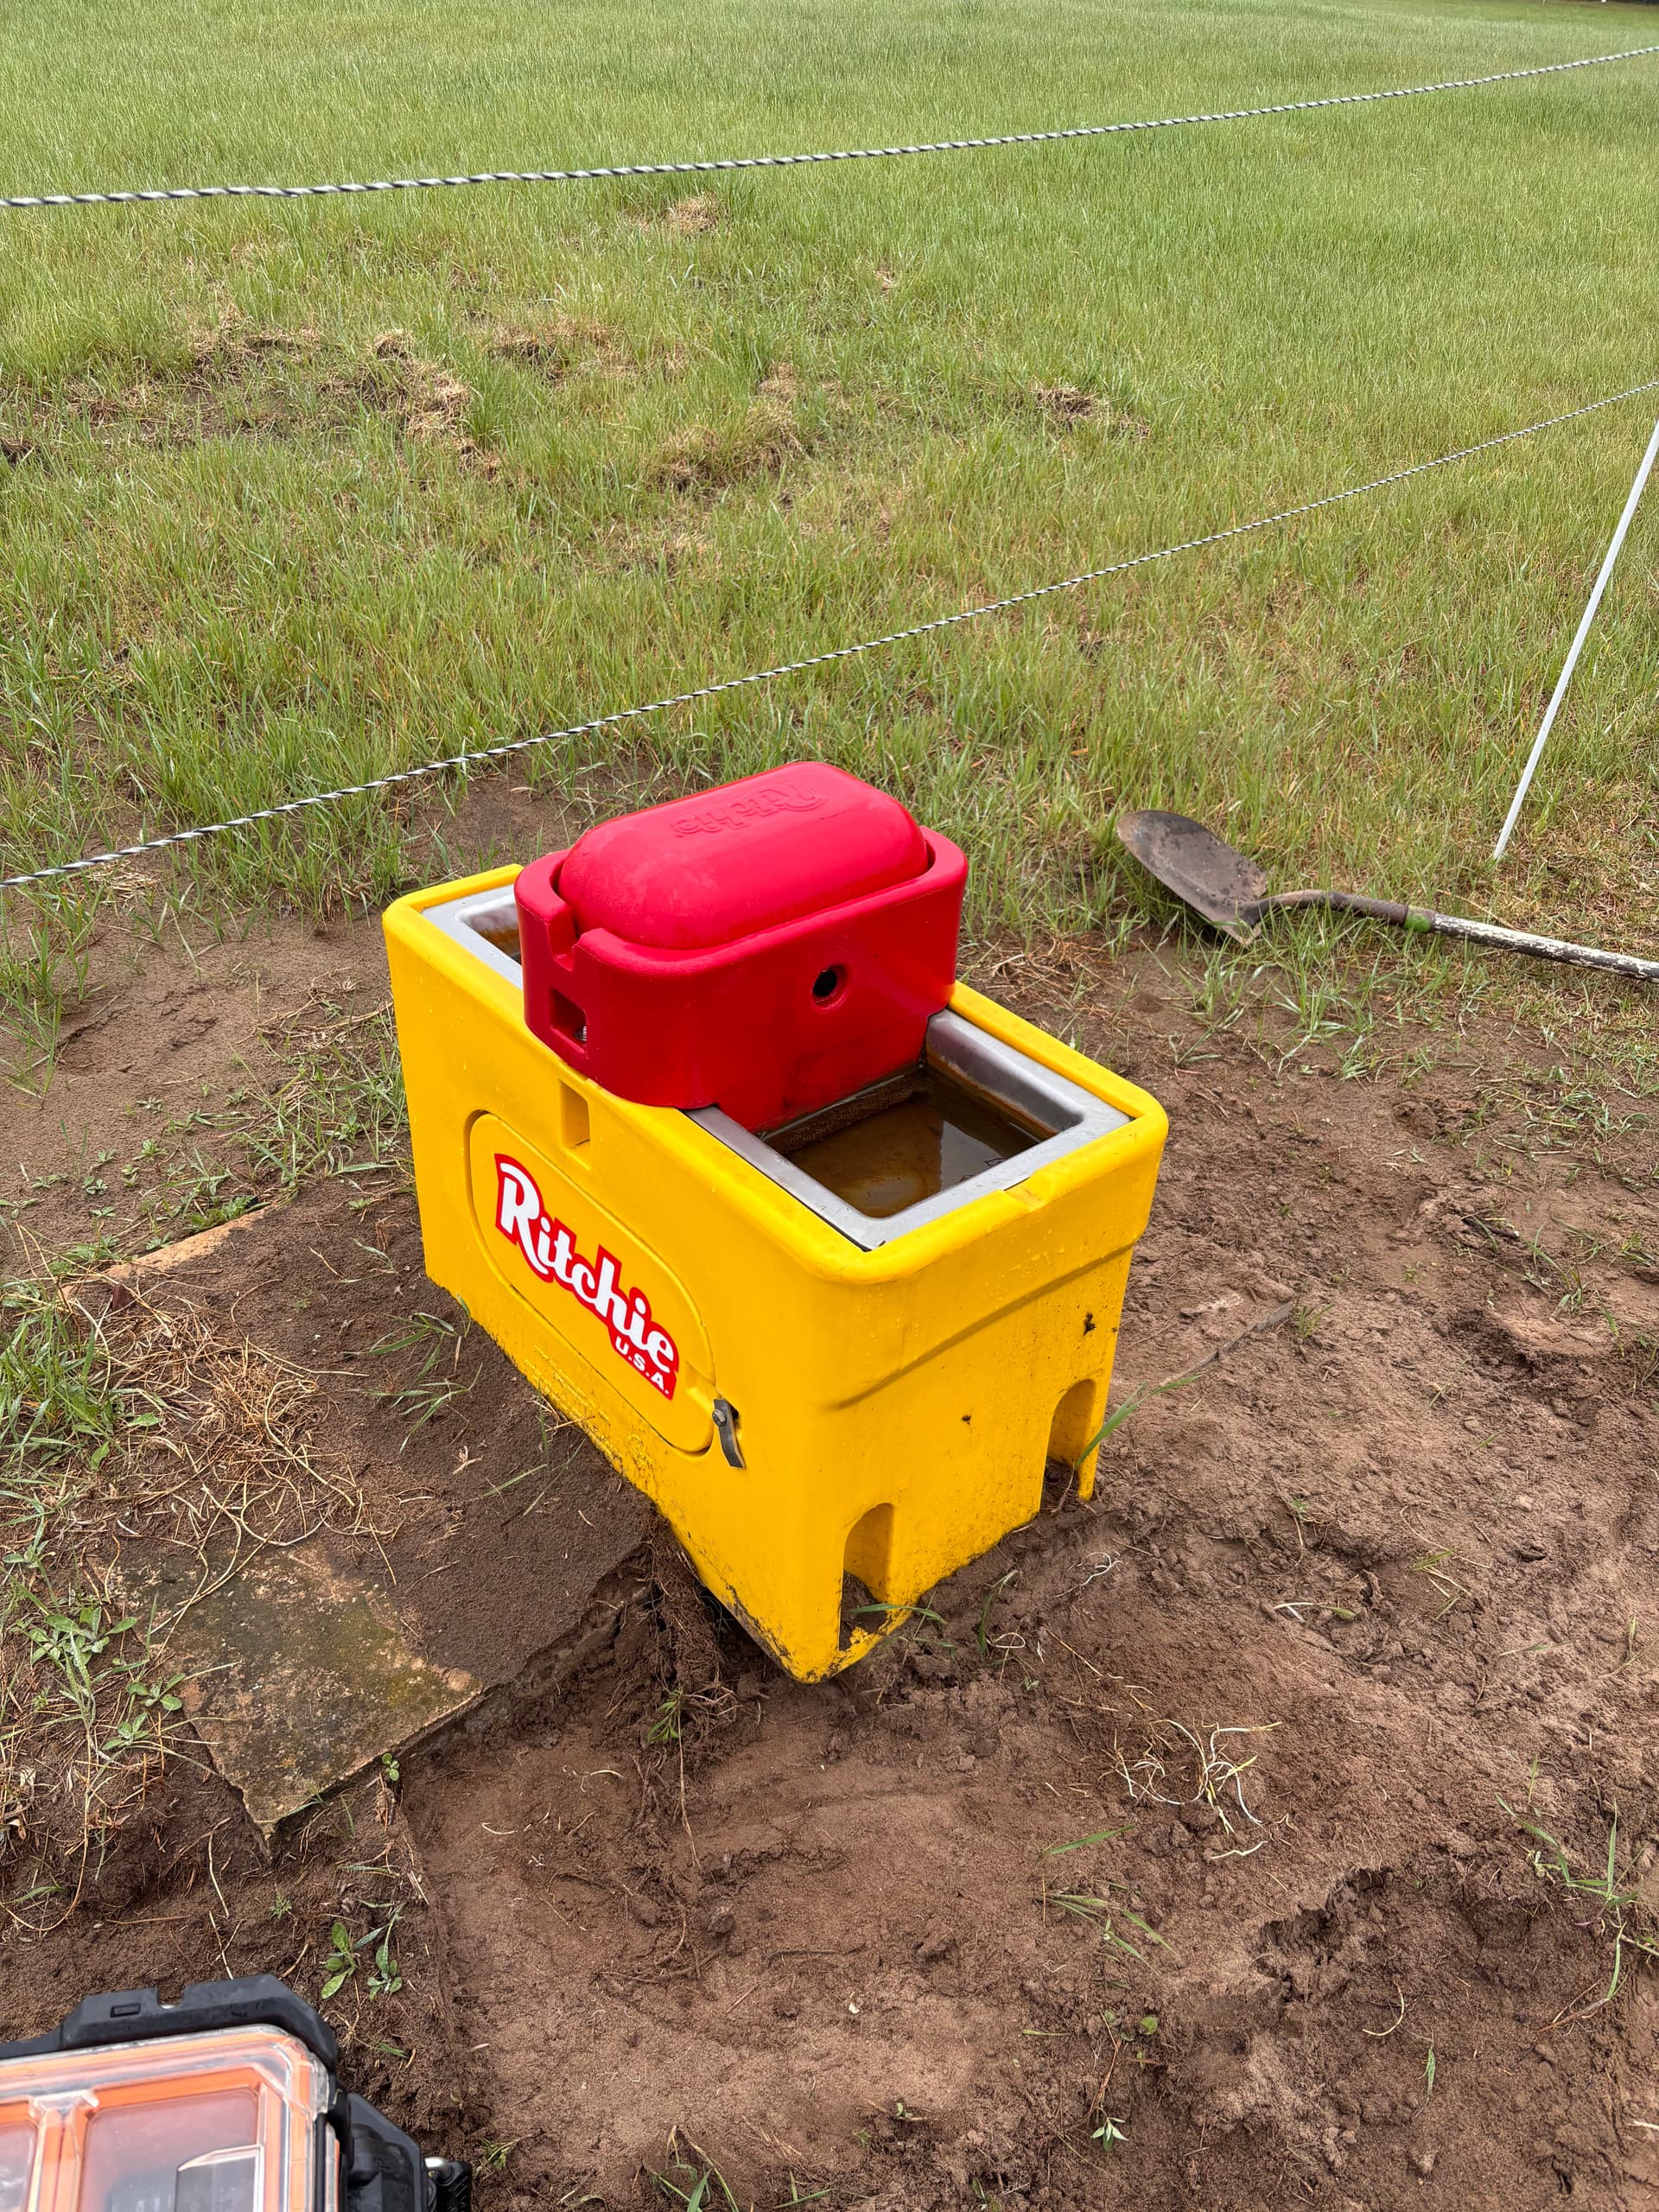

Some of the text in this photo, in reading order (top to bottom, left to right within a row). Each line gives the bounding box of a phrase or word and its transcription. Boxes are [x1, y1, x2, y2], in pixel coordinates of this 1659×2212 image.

[671, 782, 826, 837] Ritchie
[499, 1161, 675, 1374] Ritchie
[614, 1336, 671, 1395] U.S.A.
